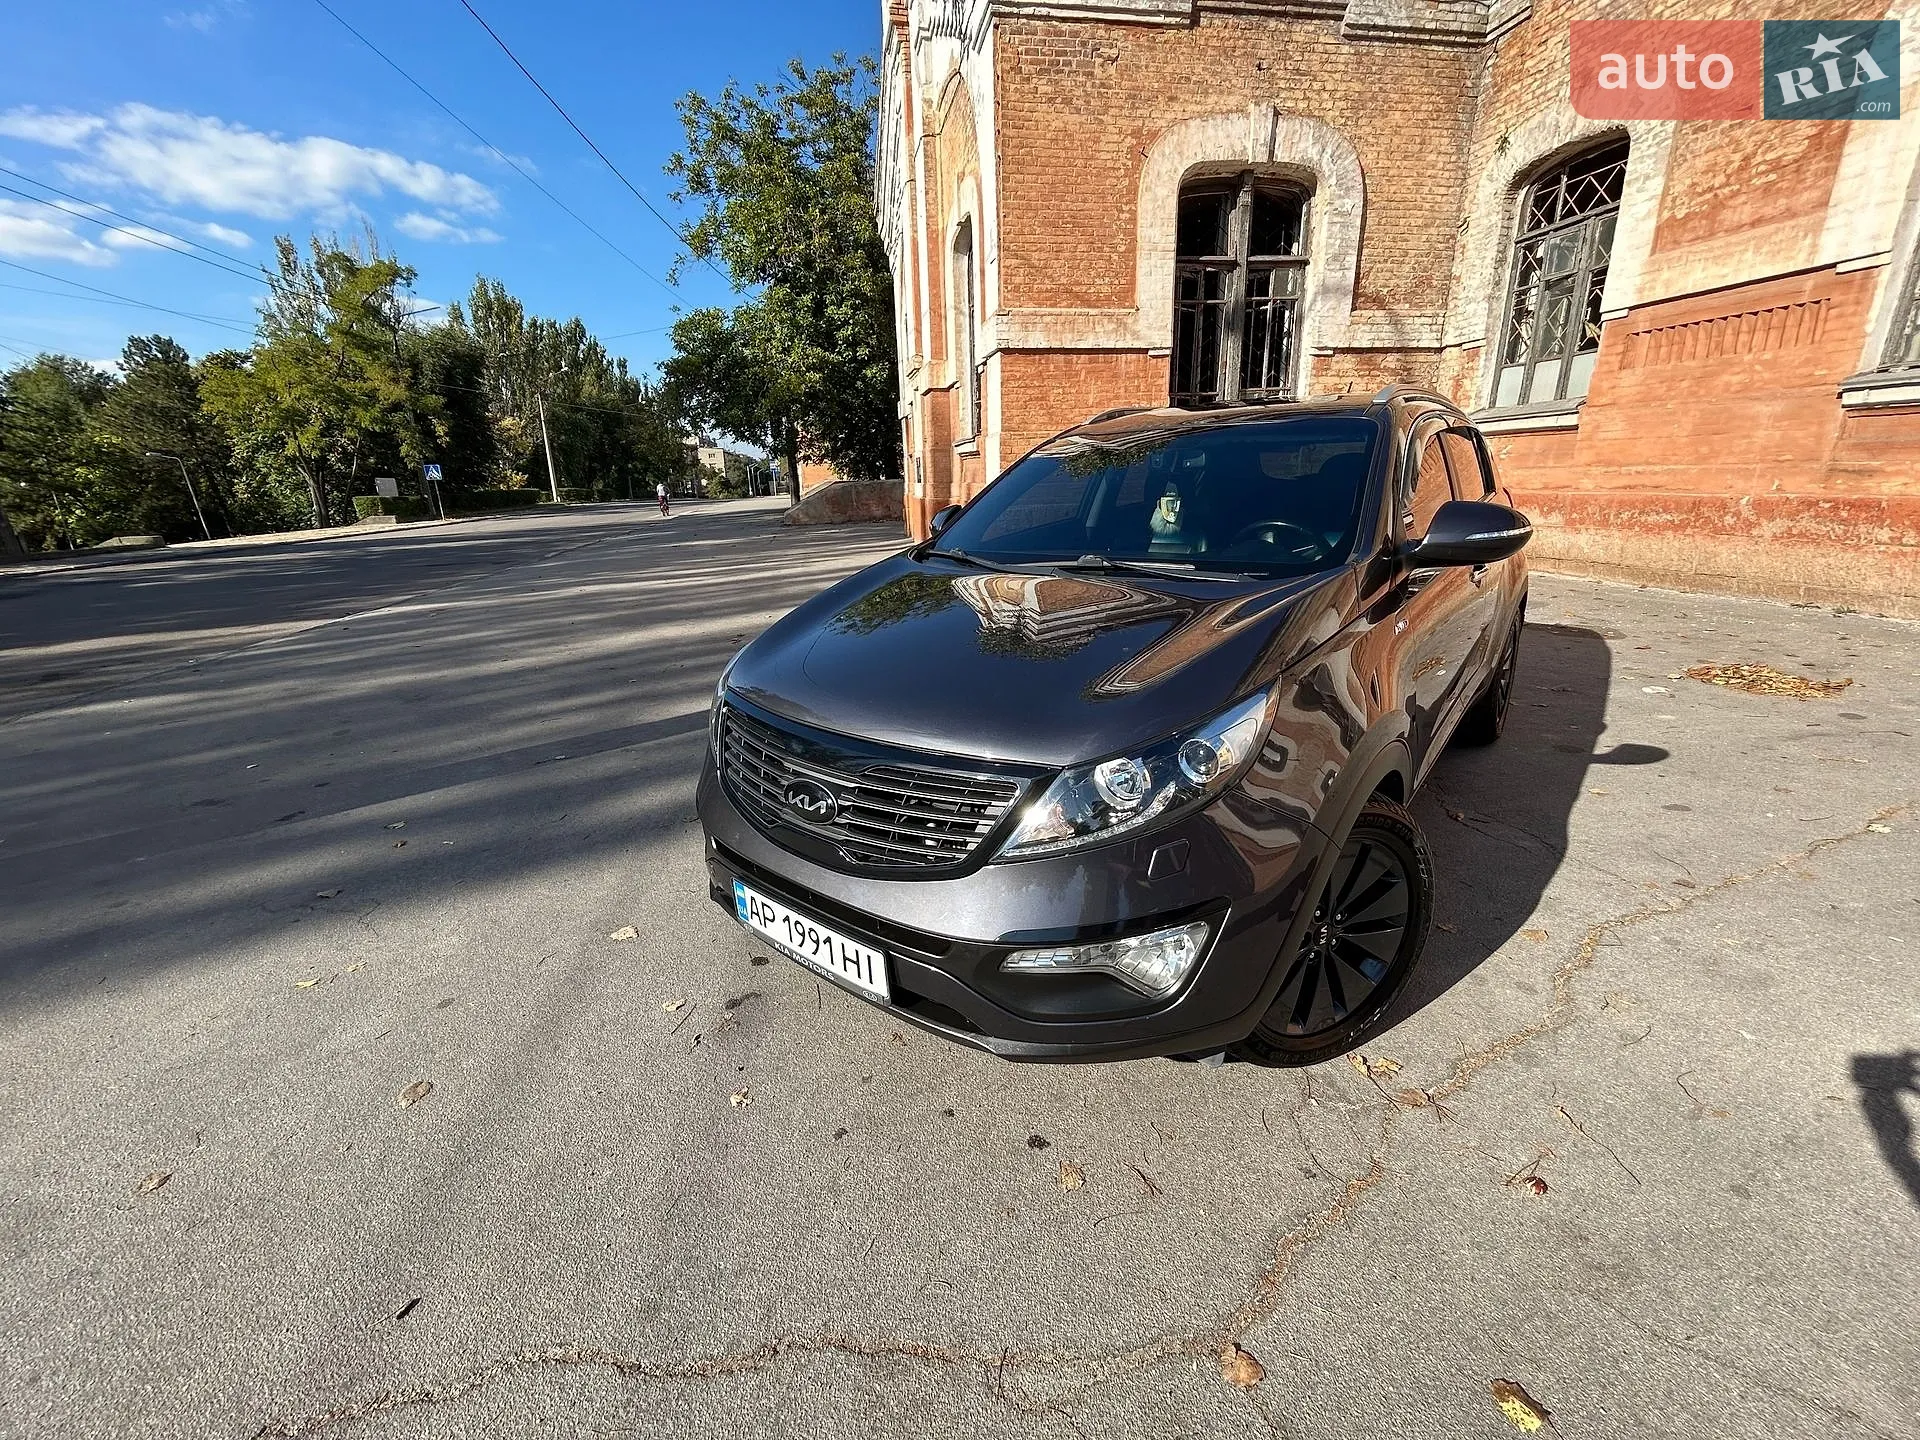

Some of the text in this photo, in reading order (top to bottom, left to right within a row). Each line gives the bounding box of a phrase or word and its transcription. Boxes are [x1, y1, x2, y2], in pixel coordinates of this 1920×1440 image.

[751, 896, 873, 984] AP 1991 HI
[1319, 924, 1328, 945] KIA
[774, 942, 835, 980] KIA MOTORS
